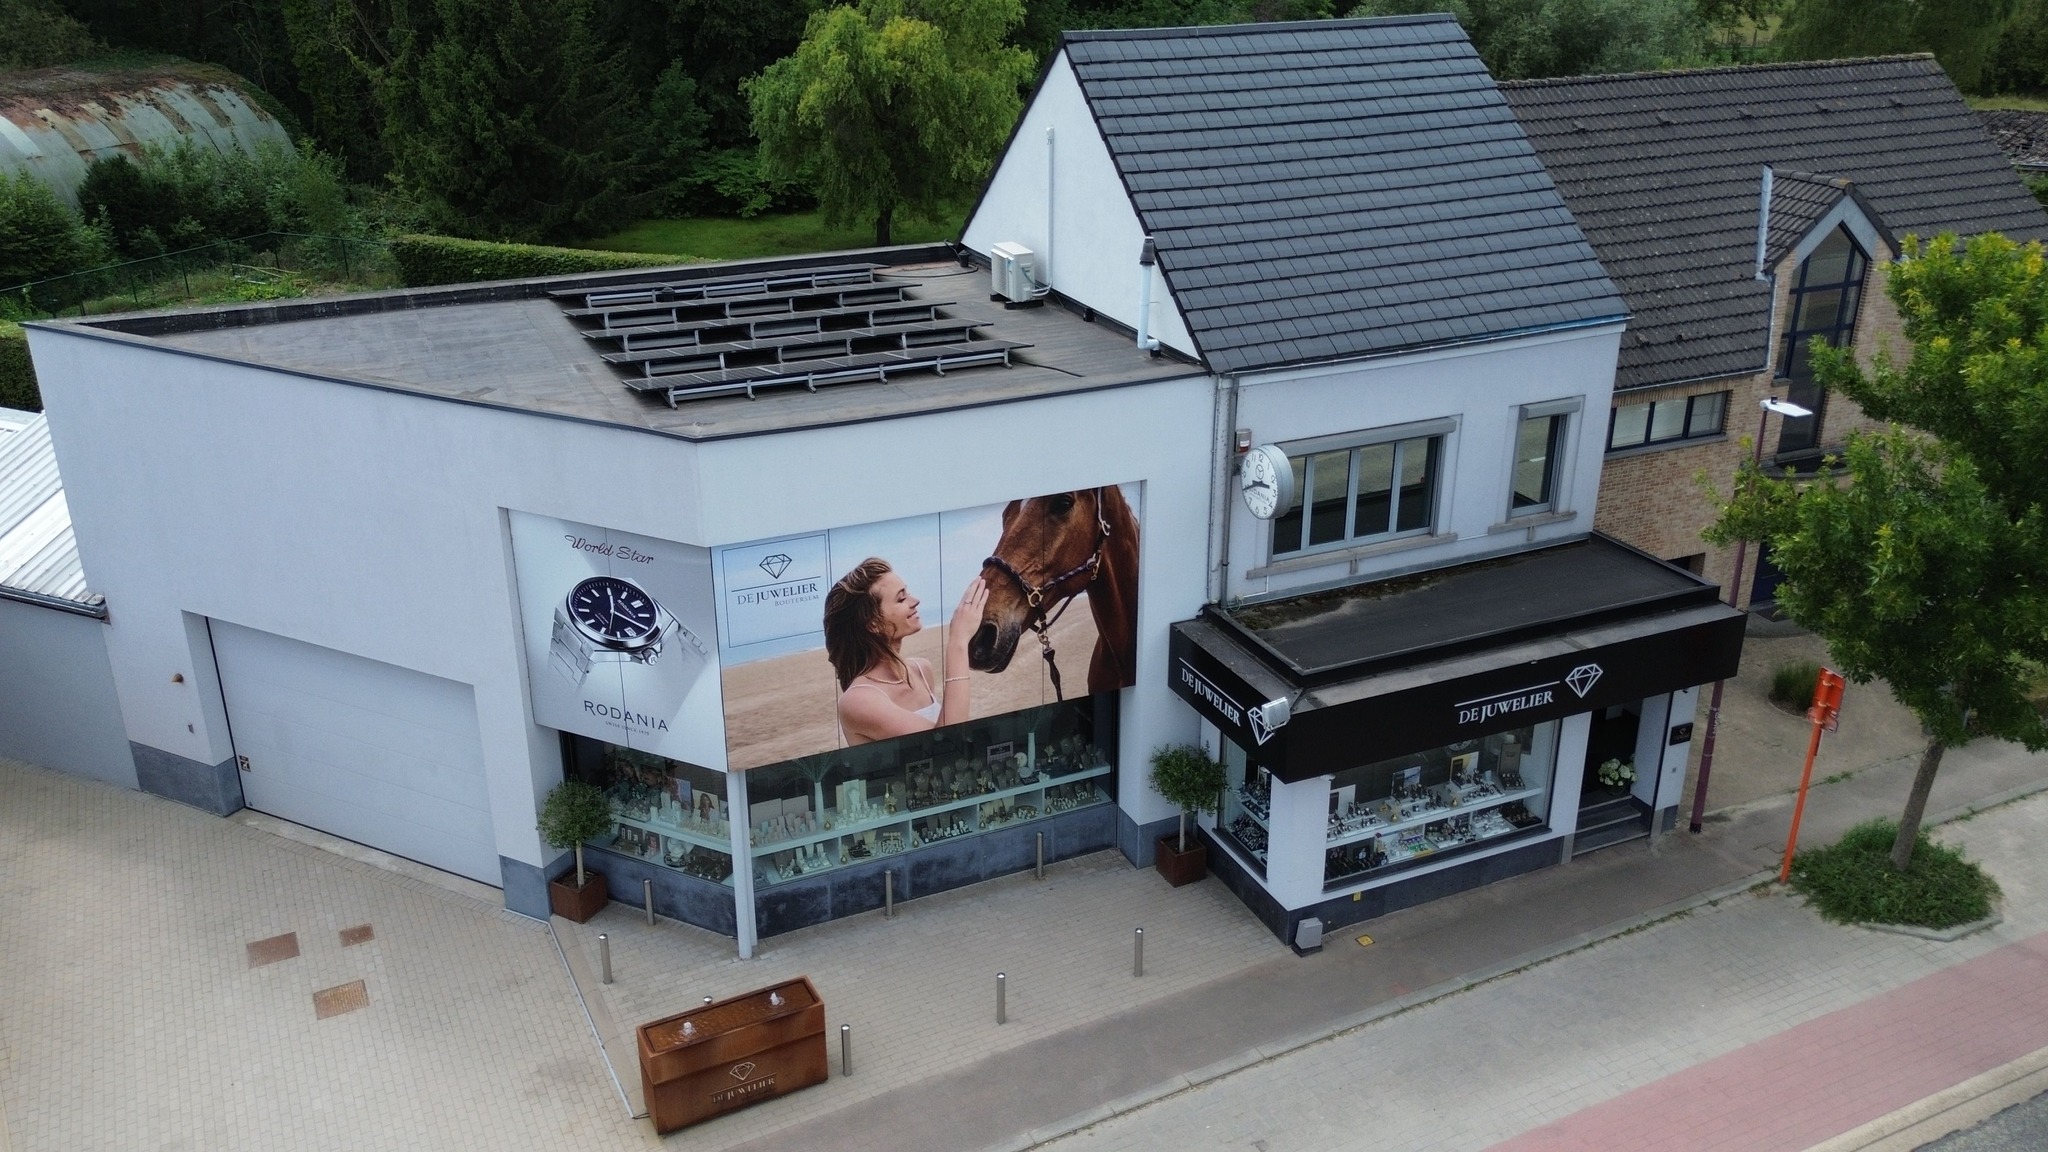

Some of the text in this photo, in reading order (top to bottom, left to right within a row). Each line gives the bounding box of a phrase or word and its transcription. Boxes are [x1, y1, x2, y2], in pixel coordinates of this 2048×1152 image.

[564, 534, 654, 564] World Star
[737, 582, 818, 605] DE JUWELIER
[774, 594, 820, 607] BOUTERSEM
[1181, 667, 1241, 727] DE JUWELIER
[1458, 690, 1554, 724] DE JUWELIER
[583, 699, 669, 732] RODANIA
